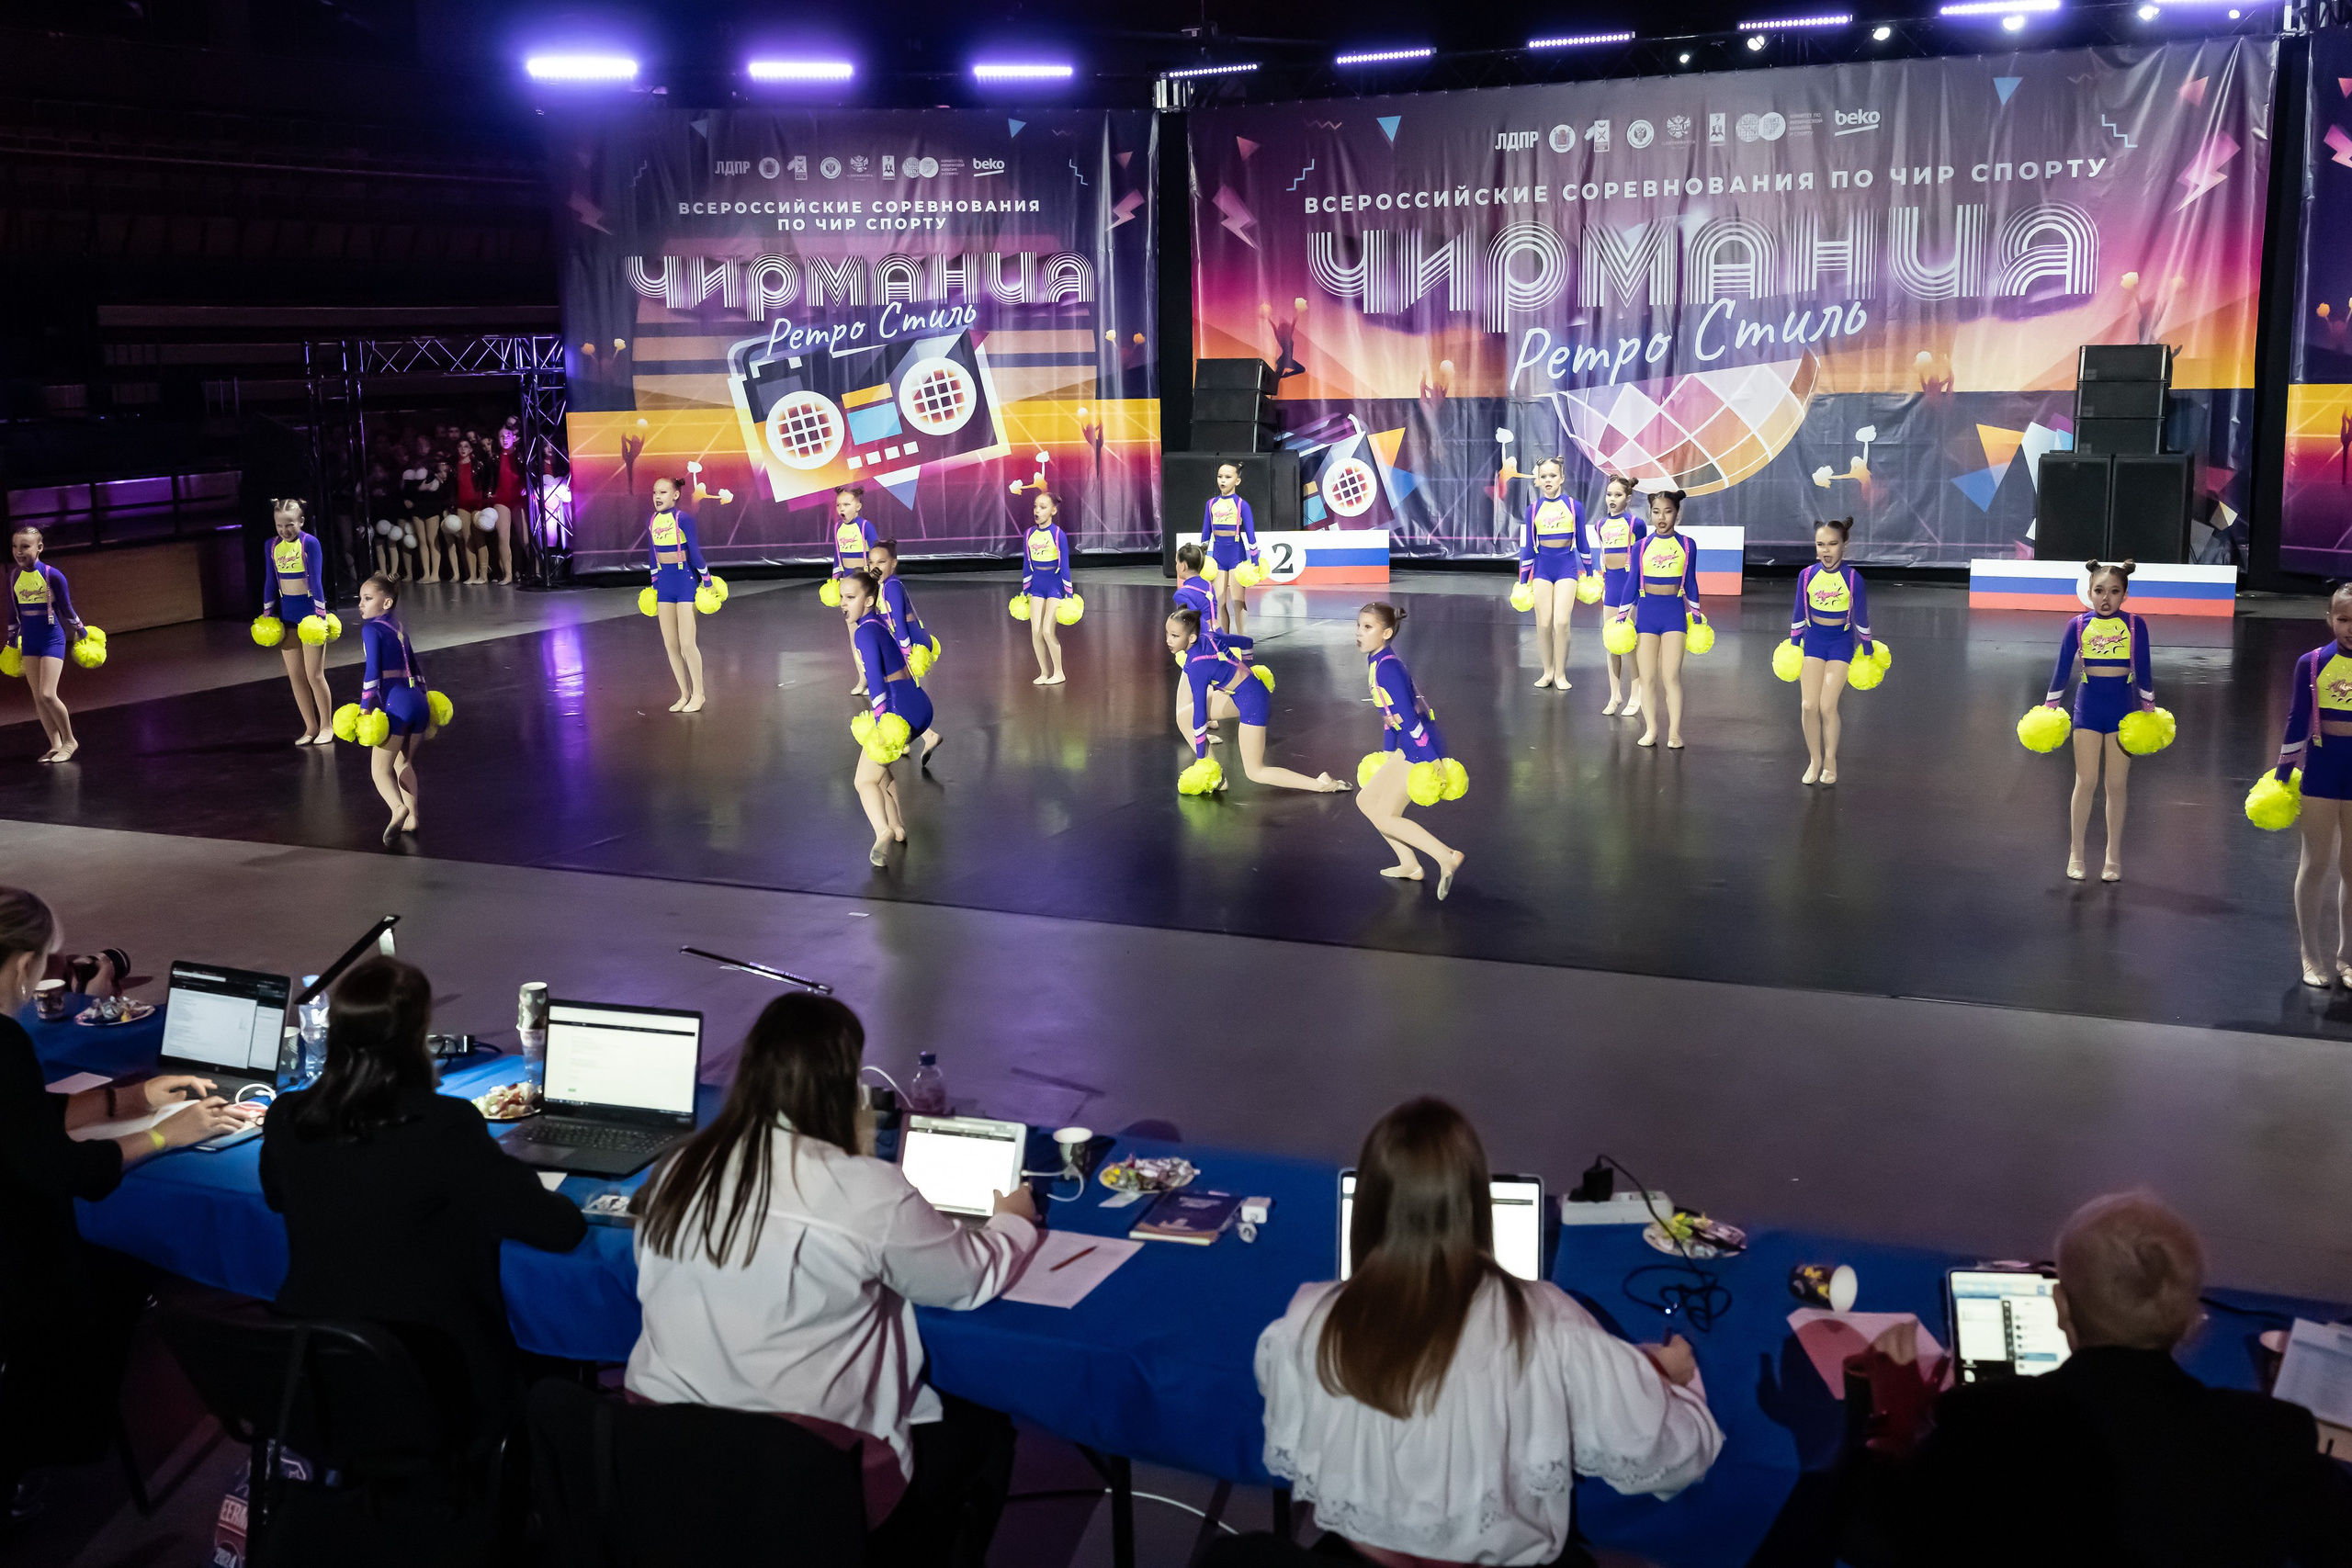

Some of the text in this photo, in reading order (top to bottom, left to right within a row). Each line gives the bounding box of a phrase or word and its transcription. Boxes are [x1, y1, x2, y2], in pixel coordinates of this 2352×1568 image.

[1835, 108, 1881, 126] beko
[1494, 131, 1539, 152] ЛДПР
[714, 161, 752, 176] ЛДПР
[972, 157, 1006, 171] beko
[1305, 157, 2107, 214] ВСЕРОССИЙСКИЕ СОРЕВНОВАНИЯ ПО ЧИР СПОРТУ
[678, 198, 1041, 215] ВСЕРОССИЙСКИЕ СОРЕВНОВАНИЯ
[777, 217, 947, 231] ПО ЧИР СПОРТУ
[766, 300, 978, 356] Ретро Стиль
[1510, 297, 1868, 391] Ретро Стиль
[1271, 542, 1294, 574] 2
